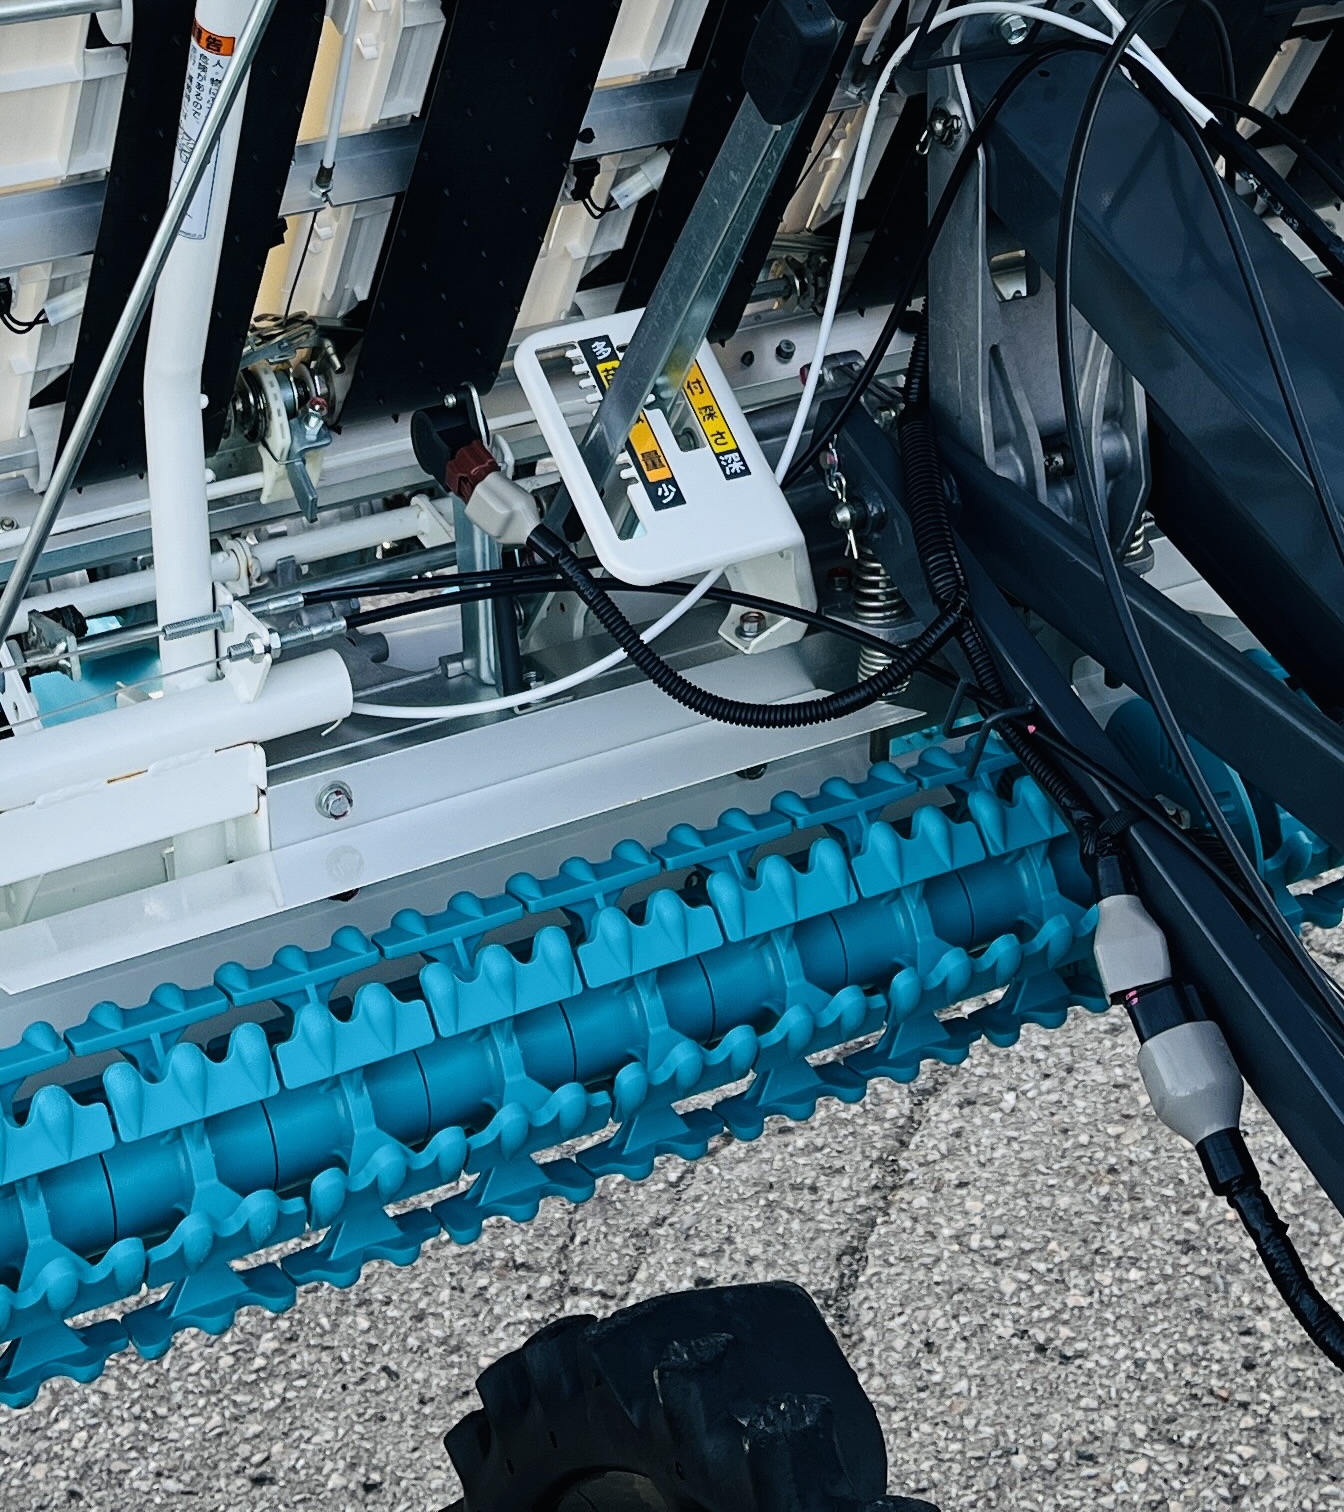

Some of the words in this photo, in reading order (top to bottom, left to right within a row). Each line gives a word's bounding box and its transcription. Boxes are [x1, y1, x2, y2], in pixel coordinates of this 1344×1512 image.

[591, 340, 611, 359] 多
[601, 366, 667, 472] 苗量
[657, 483, 677, 504] 少
[687, 377, 729, 446] 付深さ
[719, 453, 745, 475] 深
